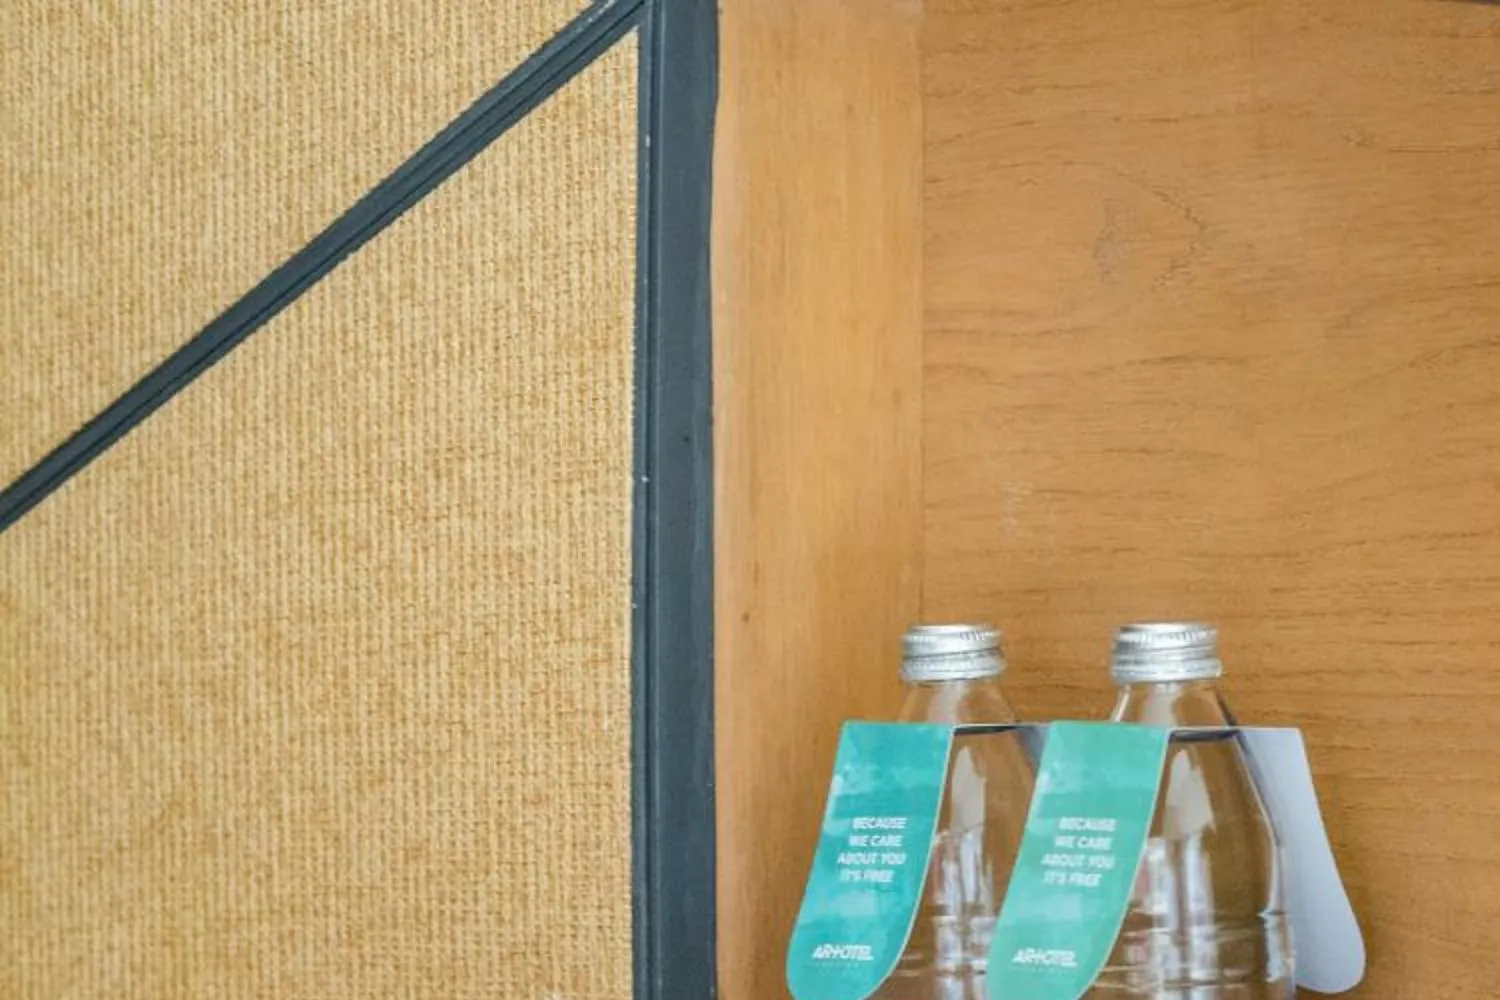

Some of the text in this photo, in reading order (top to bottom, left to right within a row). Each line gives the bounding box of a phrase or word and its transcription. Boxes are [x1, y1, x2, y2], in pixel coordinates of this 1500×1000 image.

[852, 817, 908, 829] BECAUSE
[1058, 816, 1118, 831] BECAUSE
[848, 835, 903, 847] WE CARE
[1055, 835, 1075, 848] WE
[837, 852, 907, 865] ABOUT YOU
[1041, 853, 1116, 869] ABOUT YOU
